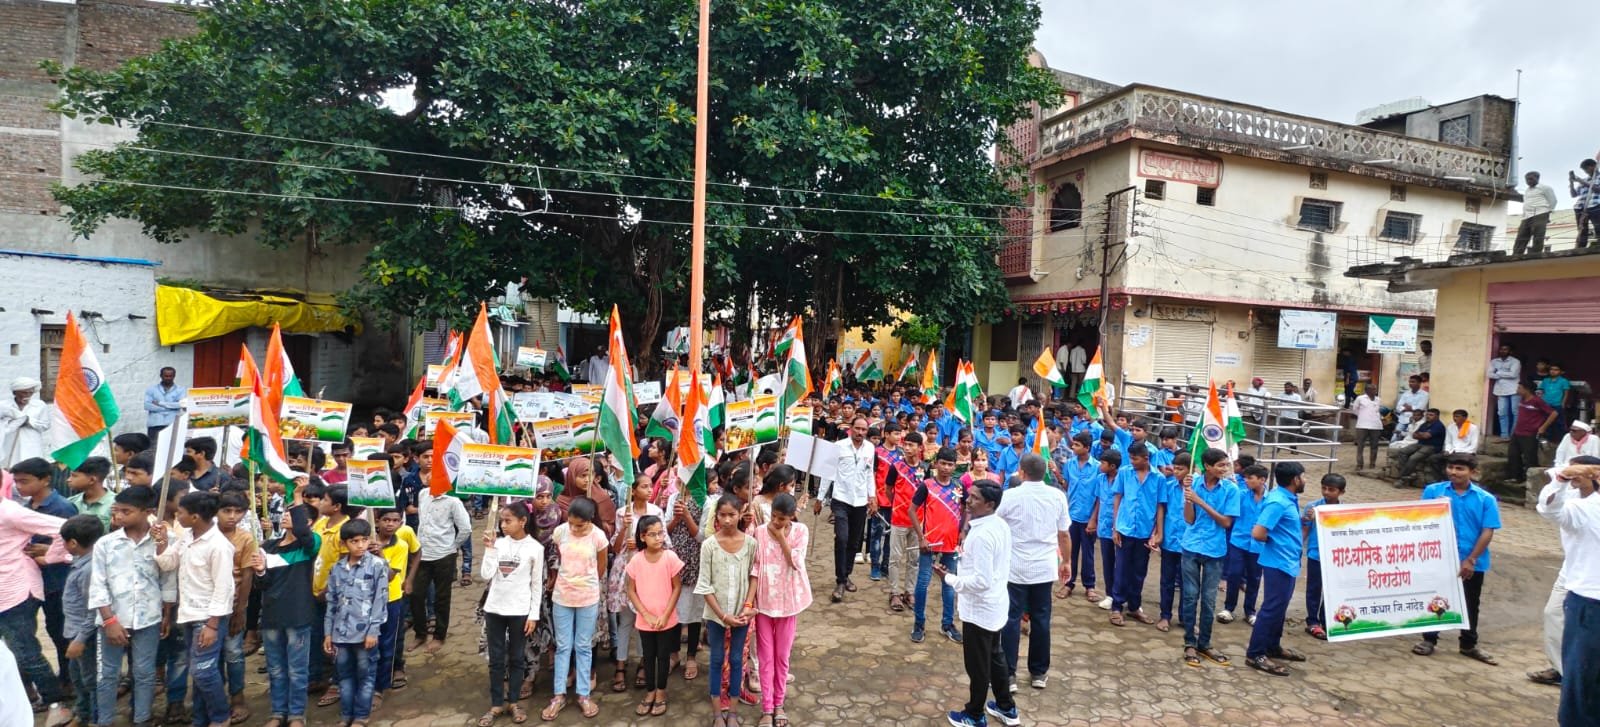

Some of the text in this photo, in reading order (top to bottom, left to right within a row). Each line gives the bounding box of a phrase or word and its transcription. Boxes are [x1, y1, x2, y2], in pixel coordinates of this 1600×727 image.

[1332, 540, 1442, 567] माध्यमिक आश्रम शाळा
